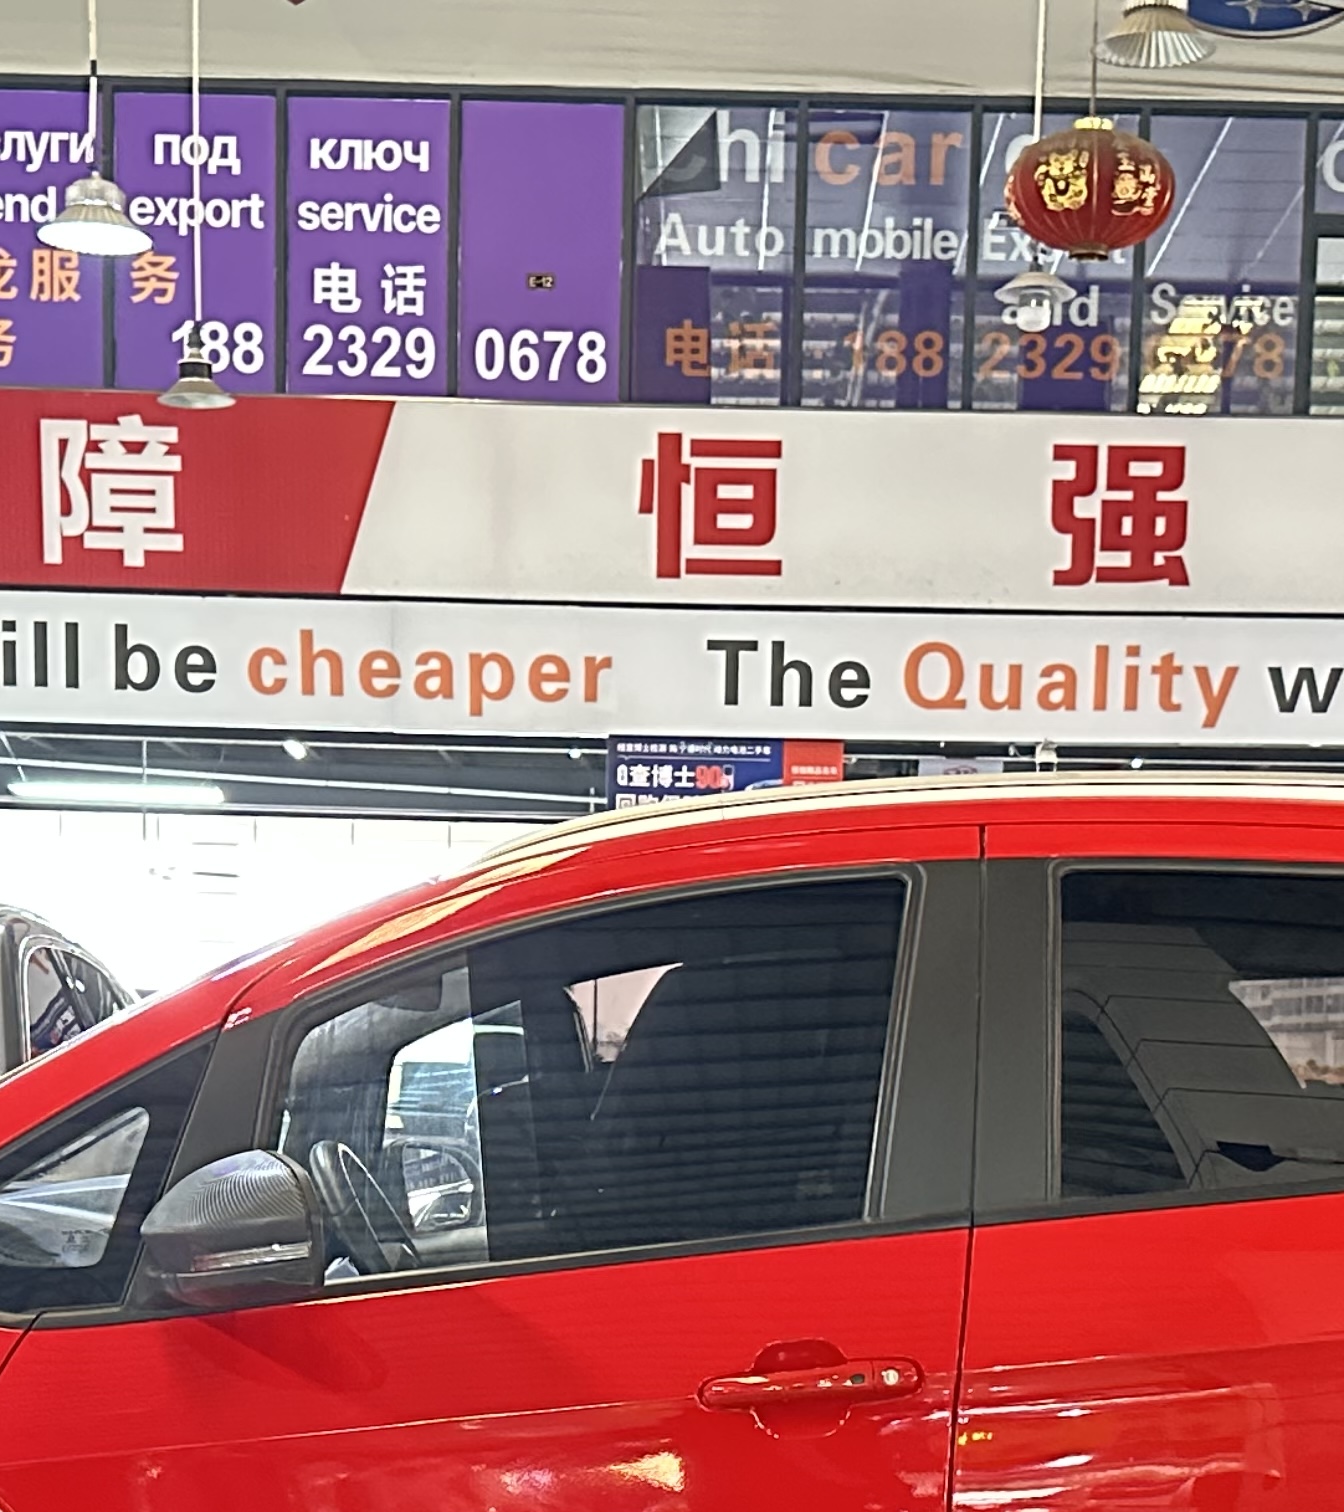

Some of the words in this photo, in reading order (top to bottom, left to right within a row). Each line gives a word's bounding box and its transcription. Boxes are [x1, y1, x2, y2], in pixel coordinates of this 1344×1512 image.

[154, 133, 241, 176] под
[309, 137, 430, 172] ключ
[716, 109, 786, 184] hi
[814, 130, 964, 187] car
[129, 194, 266, 237] export
[298, 193, 441, 235] service
[654, 212, 784, 257] Auto
[814, 217, 958, 261] mobile
[982, 218, 1126, 266] Exp
[130, 251, 180, 304] 务
[312, 262, 427, 316] 电话
[1149, 282, 1295, 326] Svice
[171, 319, 265, 375] 188
[302, 324, 436, 379] 2329
[474, 328, 607, 384] 0678
[979, 332, 1121, 381] 2329
[114, 623, 218, 693] be
[247, 629, 614, 717] cheaper
[706, 639, 872, 709] The
[902, 641, 1241, 729] Quality
